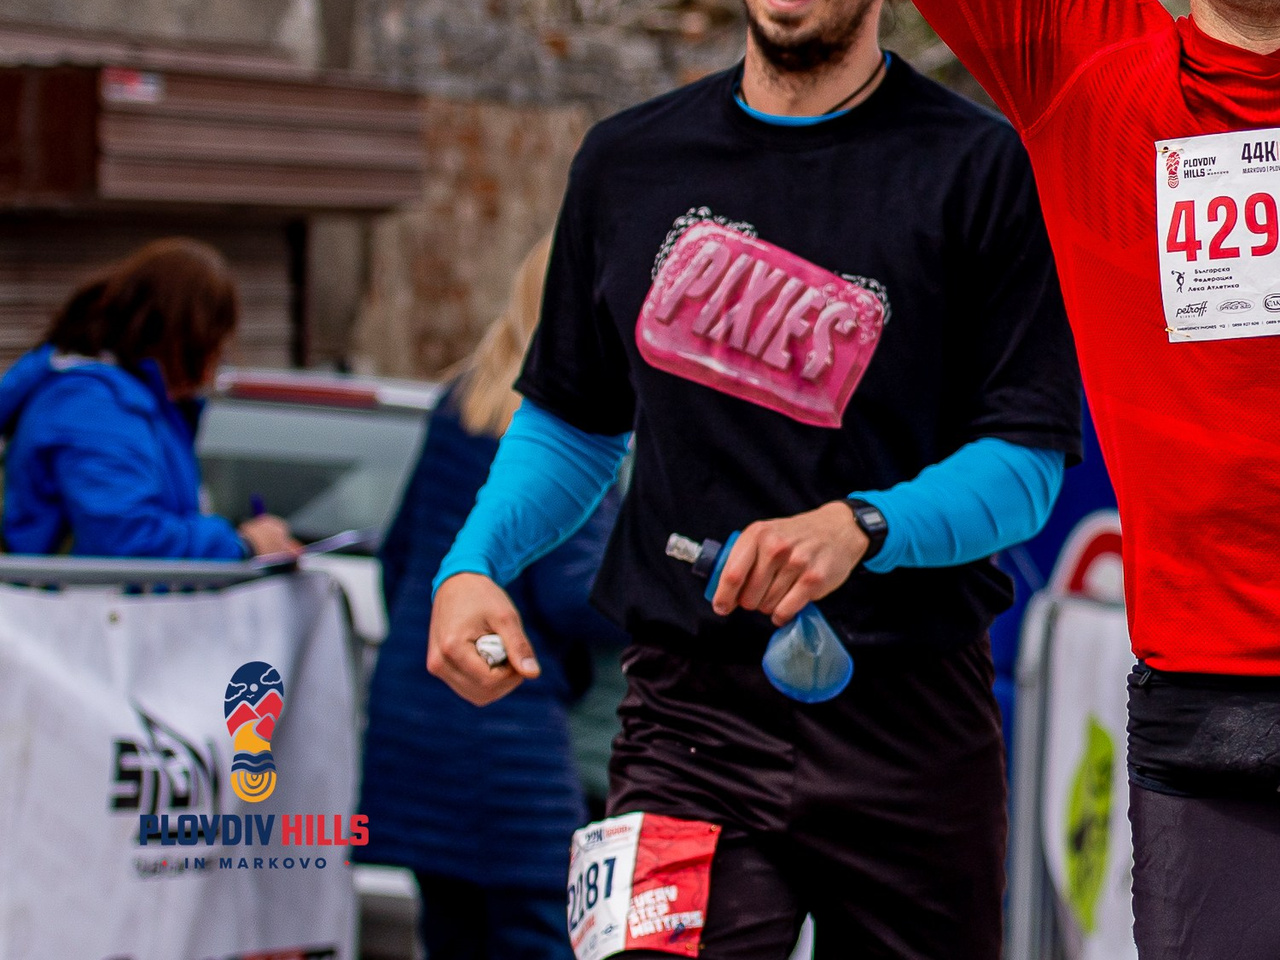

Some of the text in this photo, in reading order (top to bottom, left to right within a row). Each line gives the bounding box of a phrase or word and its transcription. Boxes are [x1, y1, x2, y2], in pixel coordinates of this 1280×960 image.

[1183, 156, 1216, 168] PLOVDIV
[1241, 141, 1276, 164] 44K
[1183, 168, 1206, 178] HILLS
[1242, 166, 1266, 174] MARKOVO
[655, 240, 858, 381] PIXIES
[568, 857, 616, 933] 2281
[630, 885, 678, 906] EVERY
[628, 900, 670, 924] STEP
